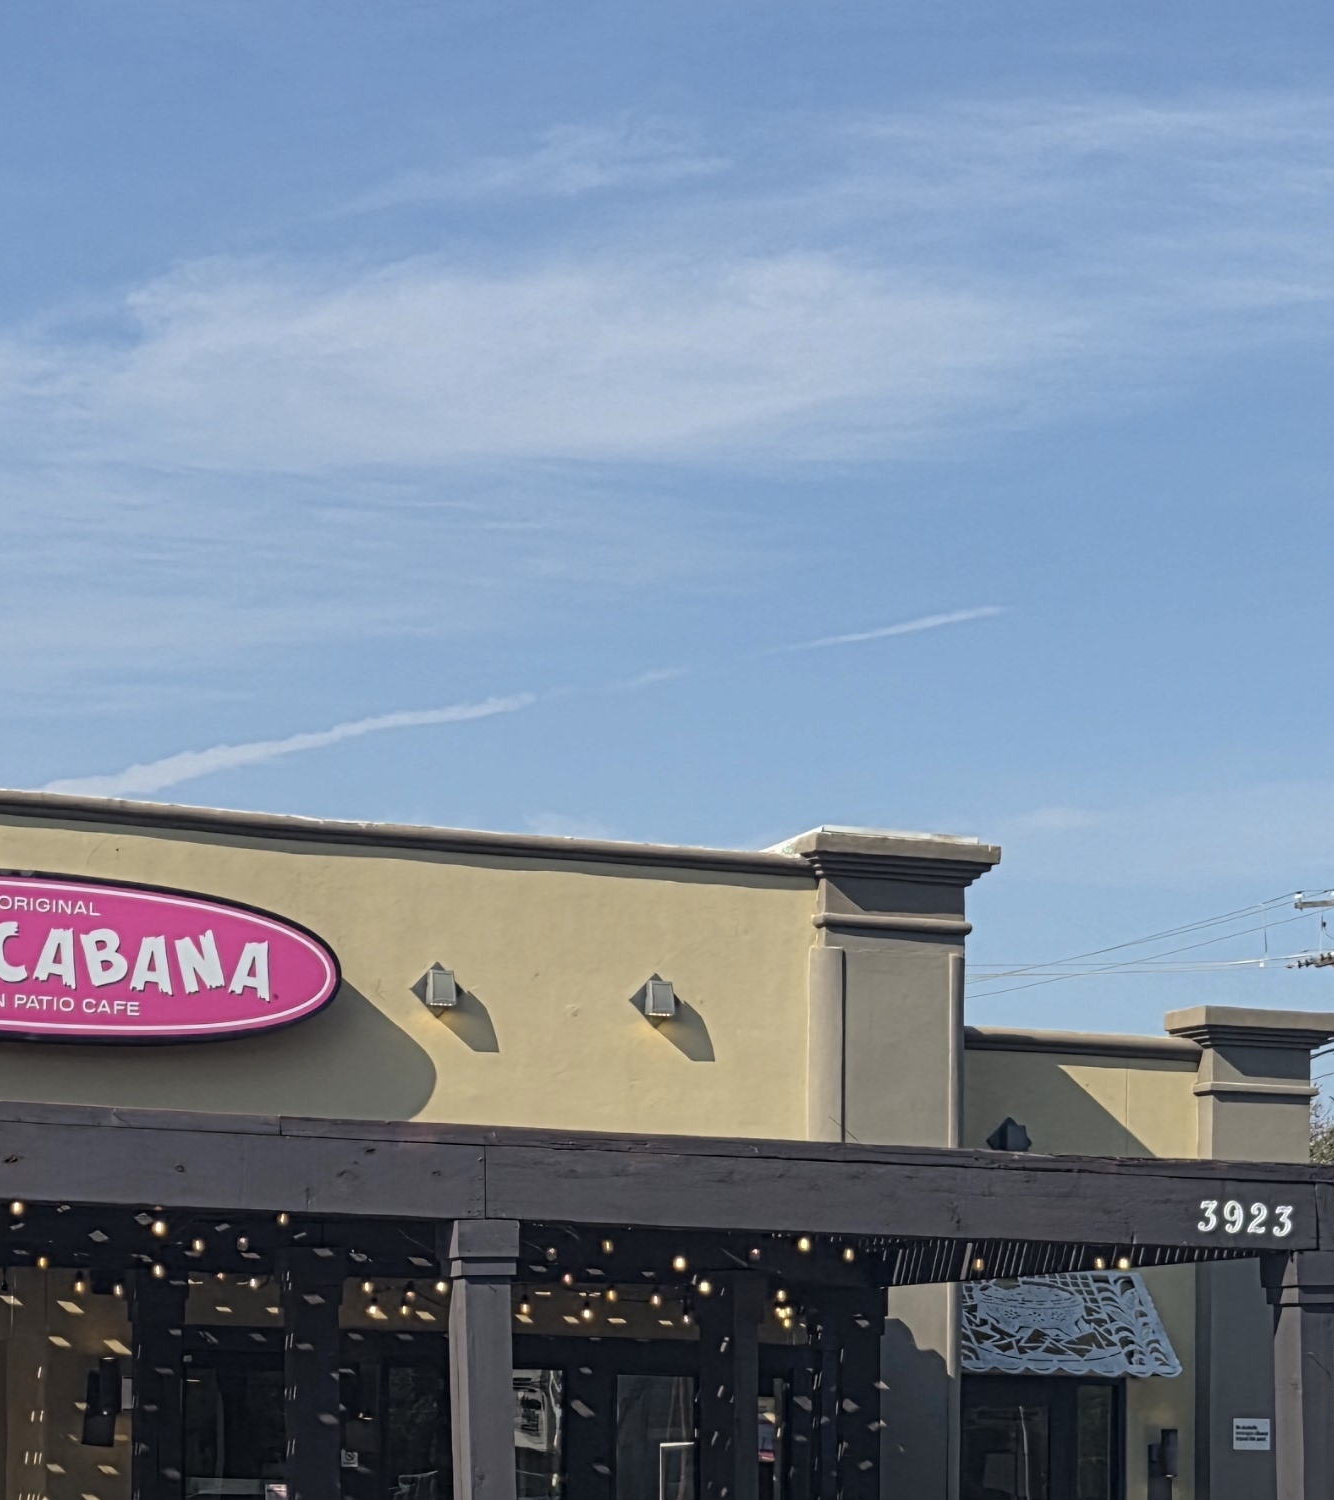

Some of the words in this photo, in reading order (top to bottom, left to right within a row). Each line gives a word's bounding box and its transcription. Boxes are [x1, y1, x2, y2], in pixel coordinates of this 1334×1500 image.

[14, 994, 75, 1012] PATIO
[82, 999, 140, 1016] CAFE
[1197, 1199, 1293, 1237] 3923
